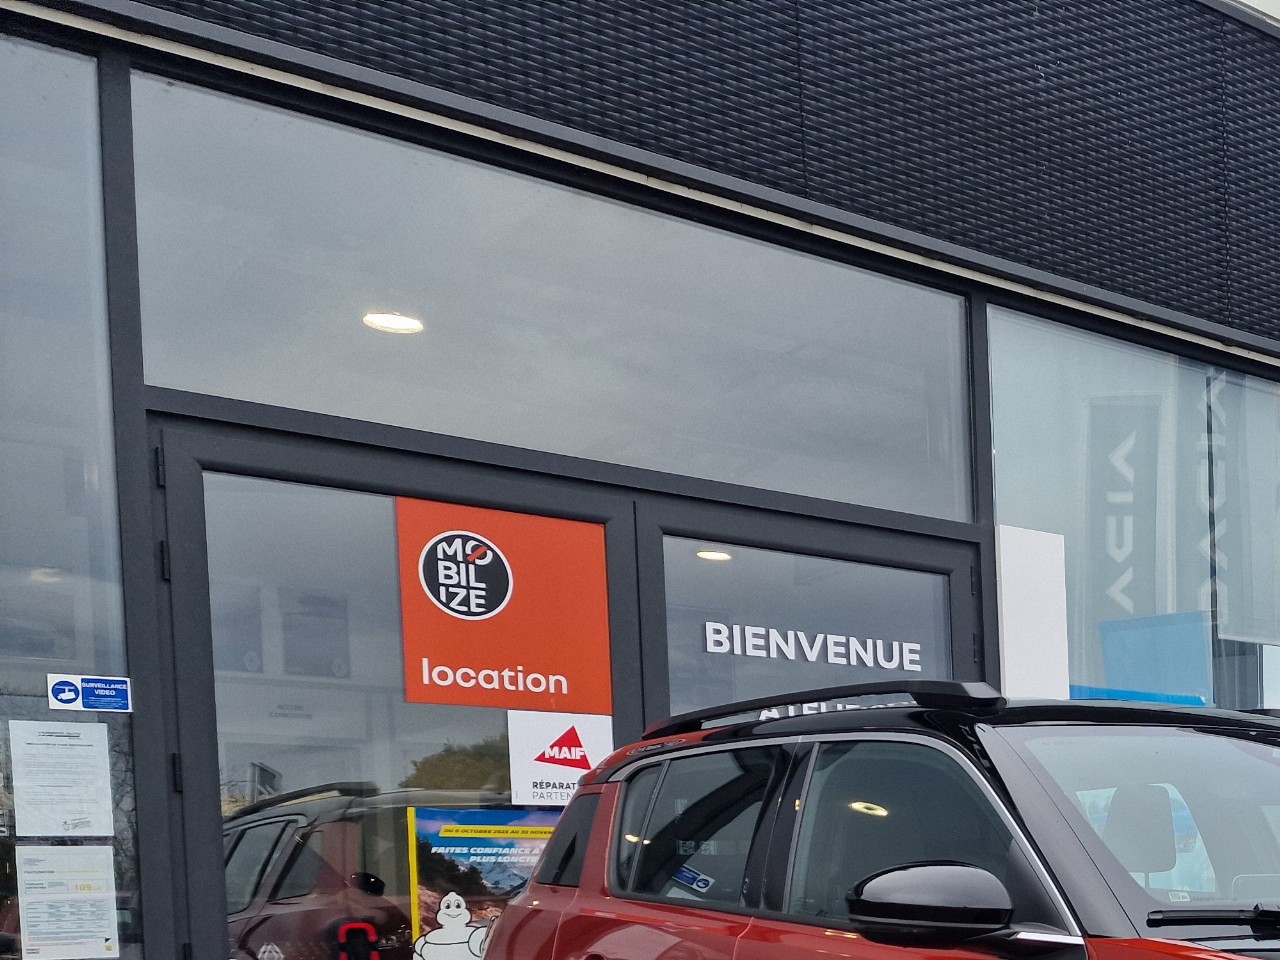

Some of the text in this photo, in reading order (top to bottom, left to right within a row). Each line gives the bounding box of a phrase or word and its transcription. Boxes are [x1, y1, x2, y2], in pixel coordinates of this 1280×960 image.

[437, 560, 487, 588] BIL
[439, 585, 487, 612] IZE
[705, 621, 922, 671] BIENVENUE
[421, 657, 568, 694] location
[544, 746, 586, 759] MAIF
[532, 780, 577, 790] RÉPARAT
[532, 791, 573, 801] PARTEN
[431, 846, 469, 854] FAITES
[469, 855, 498, 863] PLUS
